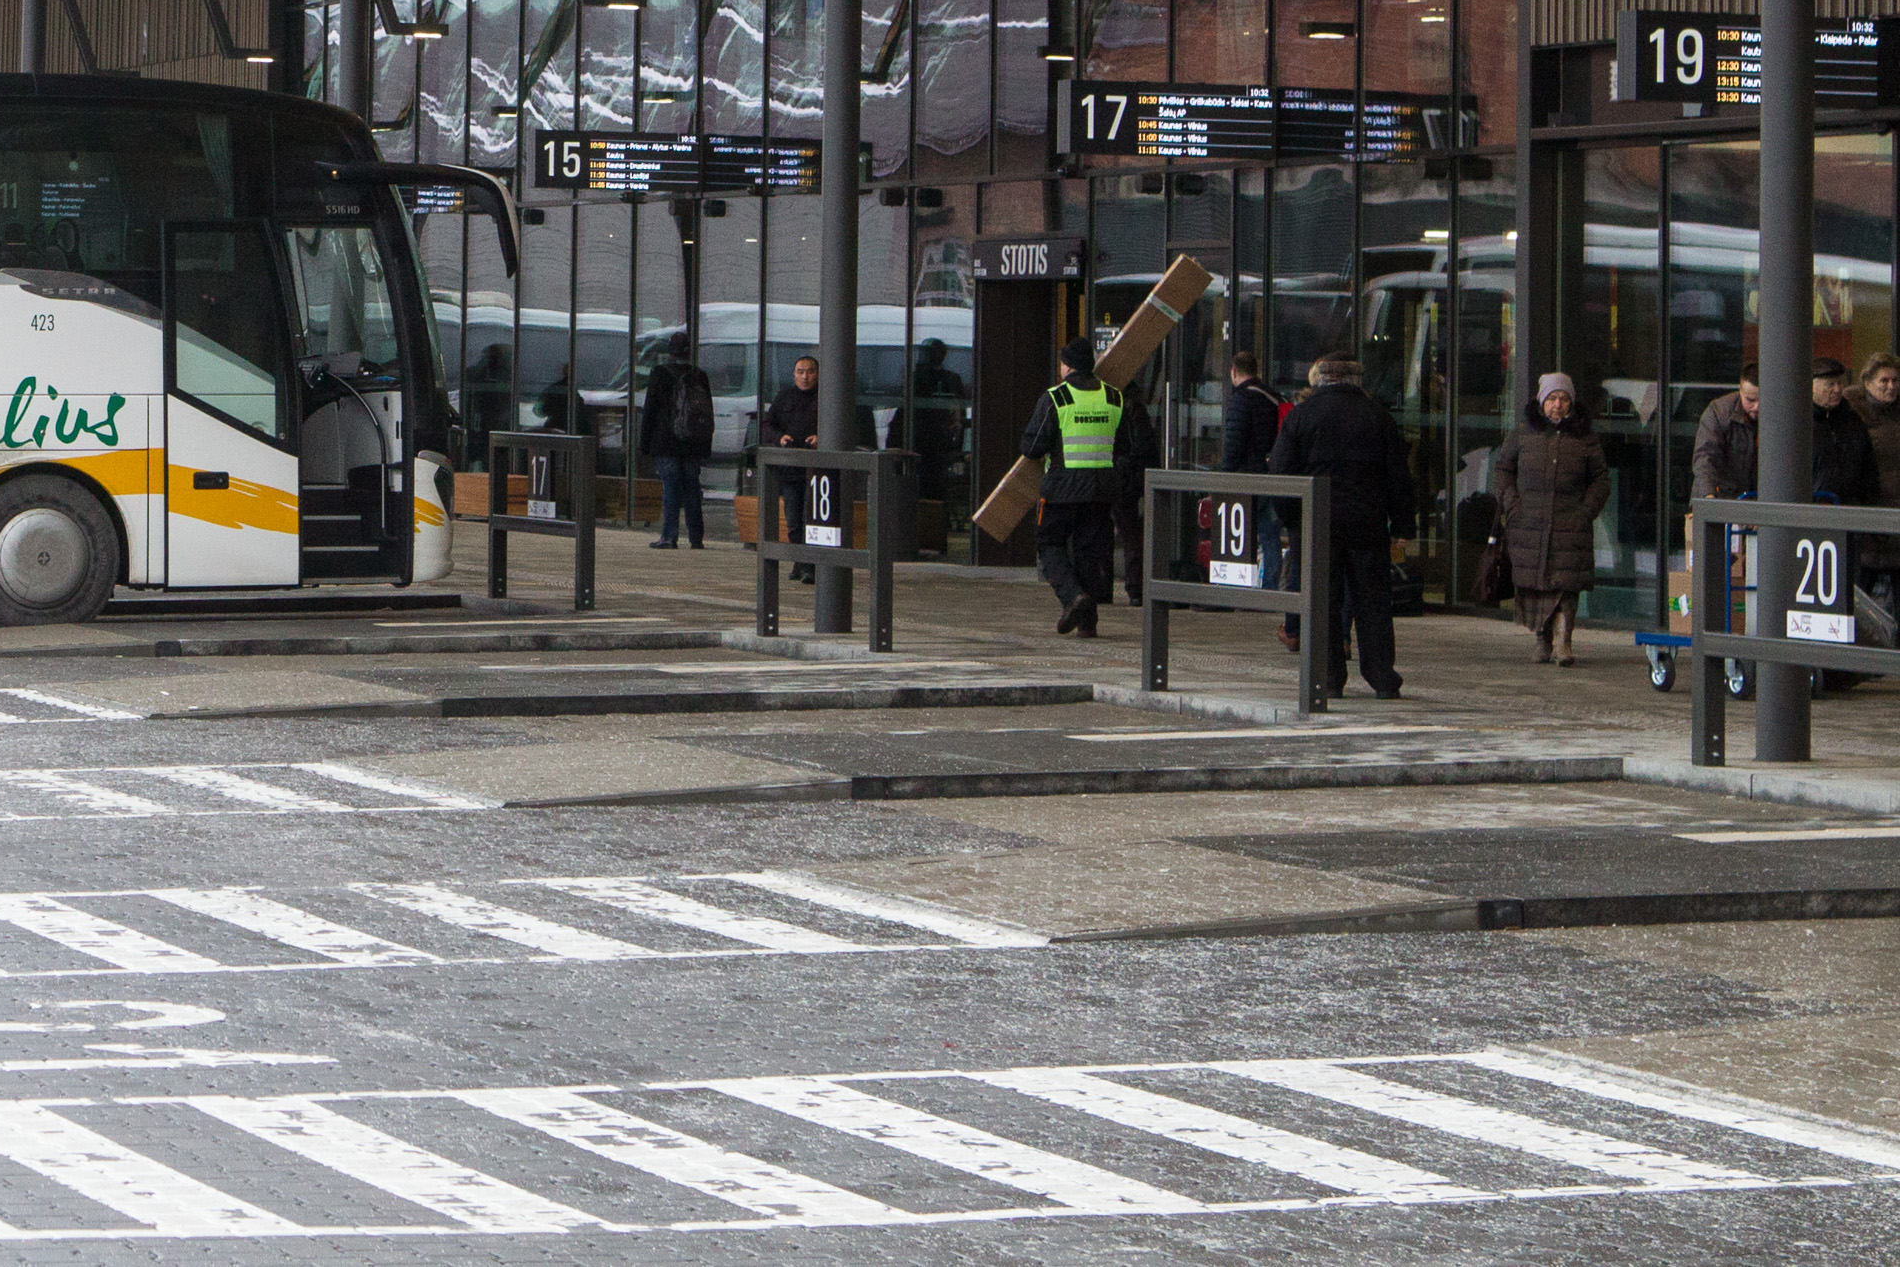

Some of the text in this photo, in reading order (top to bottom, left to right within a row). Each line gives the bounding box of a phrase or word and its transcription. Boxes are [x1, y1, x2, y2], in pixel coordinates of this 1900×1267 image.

[1852, 22, 1874, 32] 10:32
[1717, 30, 1740, 41] 10:30
[1742, 31, 1761, 42] Kaun
[1649, 28, 1704, 85] 19
[1717, 60, 1761, 72] 12:30 Kaun
[1717, 76, 1761, 87] 13:15 Kaun
[1251, 88, 1269, 97] 10:32
[1717, 92, 1761, 103] 13:30 Kaun
[1138, 96, 1158, 105] 10:30
[1081, 94, 1128, 140] 17
[1177, 109, 1187, 118] AP
[1138, 121, 1158, 130] 10:45
[1159, 122, 1183, 131] Kaunas
[1138, 133, 1158, 142] 11:00
[1159, 134, 1183, 143] Kaunas
[1138, 146, 1158, 155] 11:15
[1159, 146, 1183, 156] Kaunas
[544, 141, 581, 178] 15
[1001, 244, 1048, 275] STOTIS
[42, 287, 116, 295] SETRA
[31, 314, 55, 331] 423
[531, 456, 547, 495] 17
[810, 475, 830, 521] 18
[1217, 502, 1245, 557] 19
[1795, 539, 1838, 606] 20
